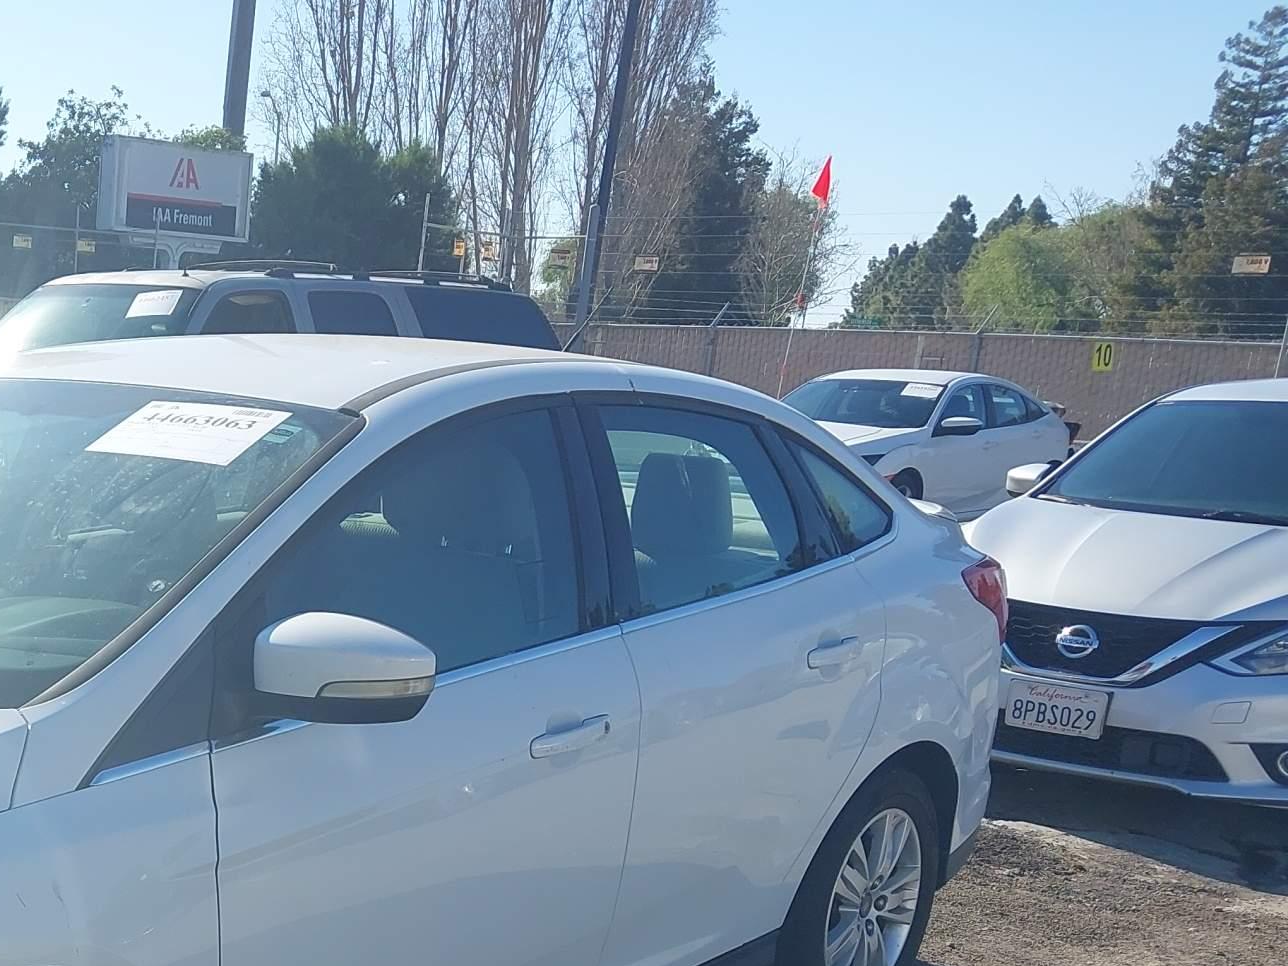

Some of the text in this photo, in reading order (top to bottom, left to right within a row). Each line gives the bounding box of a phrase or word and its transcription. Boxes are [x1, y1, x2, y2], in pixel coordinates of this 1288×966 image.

[152, 207, 212, 227] IAA Fremont
[1095, 343, 1112, 367] 10
[143, 412, 257, 430] 44663063
[1059, 636, 1094, 647] NISSAN
[1028, 684, 1084, 702] California
[1011, 698, 1097, 731] 8PBS029
